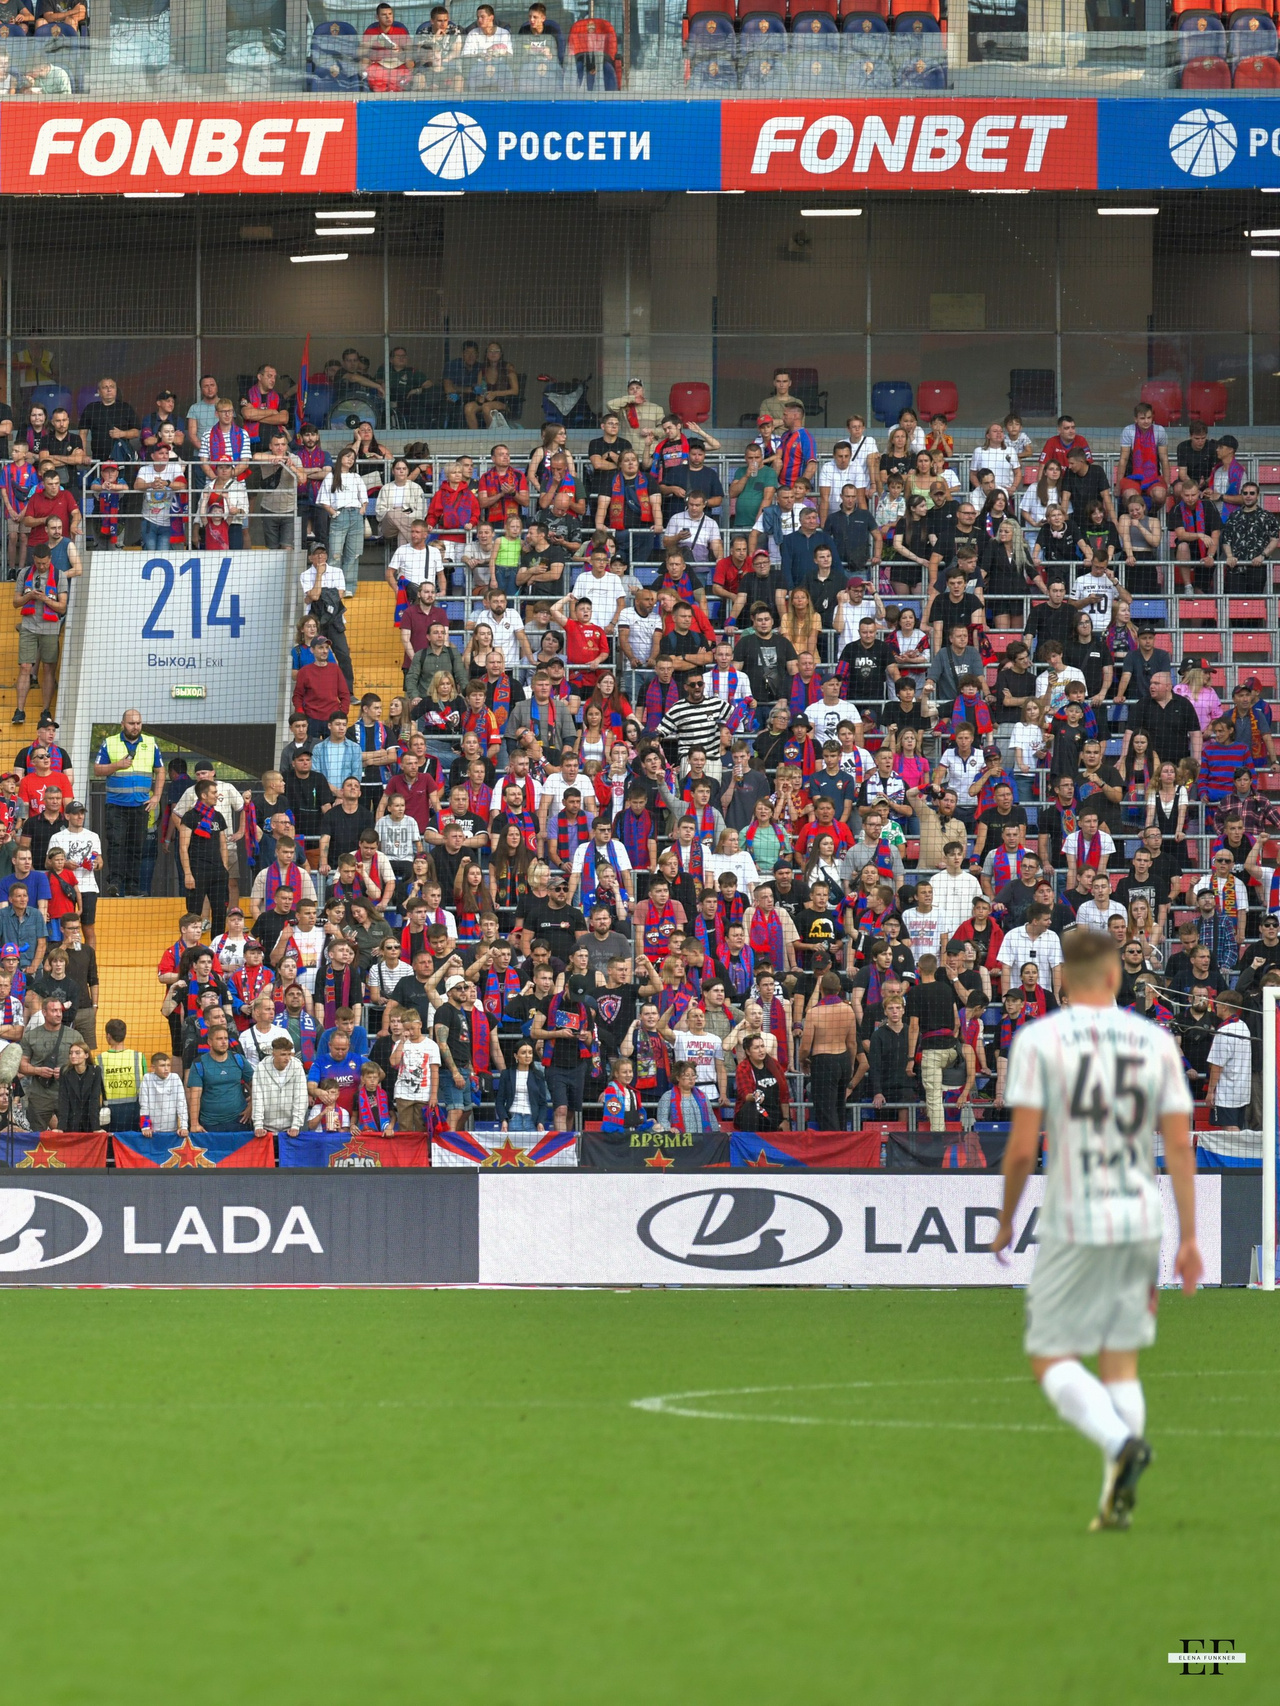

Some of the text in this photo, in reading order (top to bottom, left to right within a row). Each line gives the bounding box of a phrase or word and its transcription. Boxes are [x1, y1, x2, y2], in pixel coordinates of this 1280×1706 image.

[29, 117, 344, 177] FONBET
[498, 131, 650, 161] РОССЕТИ
[750, 115, 1068, 174] FONBET
[141, 557, 246, 640] 214
[1089, 594, 1108, 614] 10
[147, 653, 197, 669] Выход
[205, 657, 223, 668] Exit
[175, 687, 202, 697] ВЫХОД
[686, 1041, 715, 1049] АРМЕЙЦЫ
[108, 1080, 133, 1089] K0292
[334, 1075, 354, 1083] ИКС
[1070, 1053, 1145, 1135] 45
[629, 1132, 694, 1148] ВРЕМЯ
[123, 1206, 324, 1254] LADA
